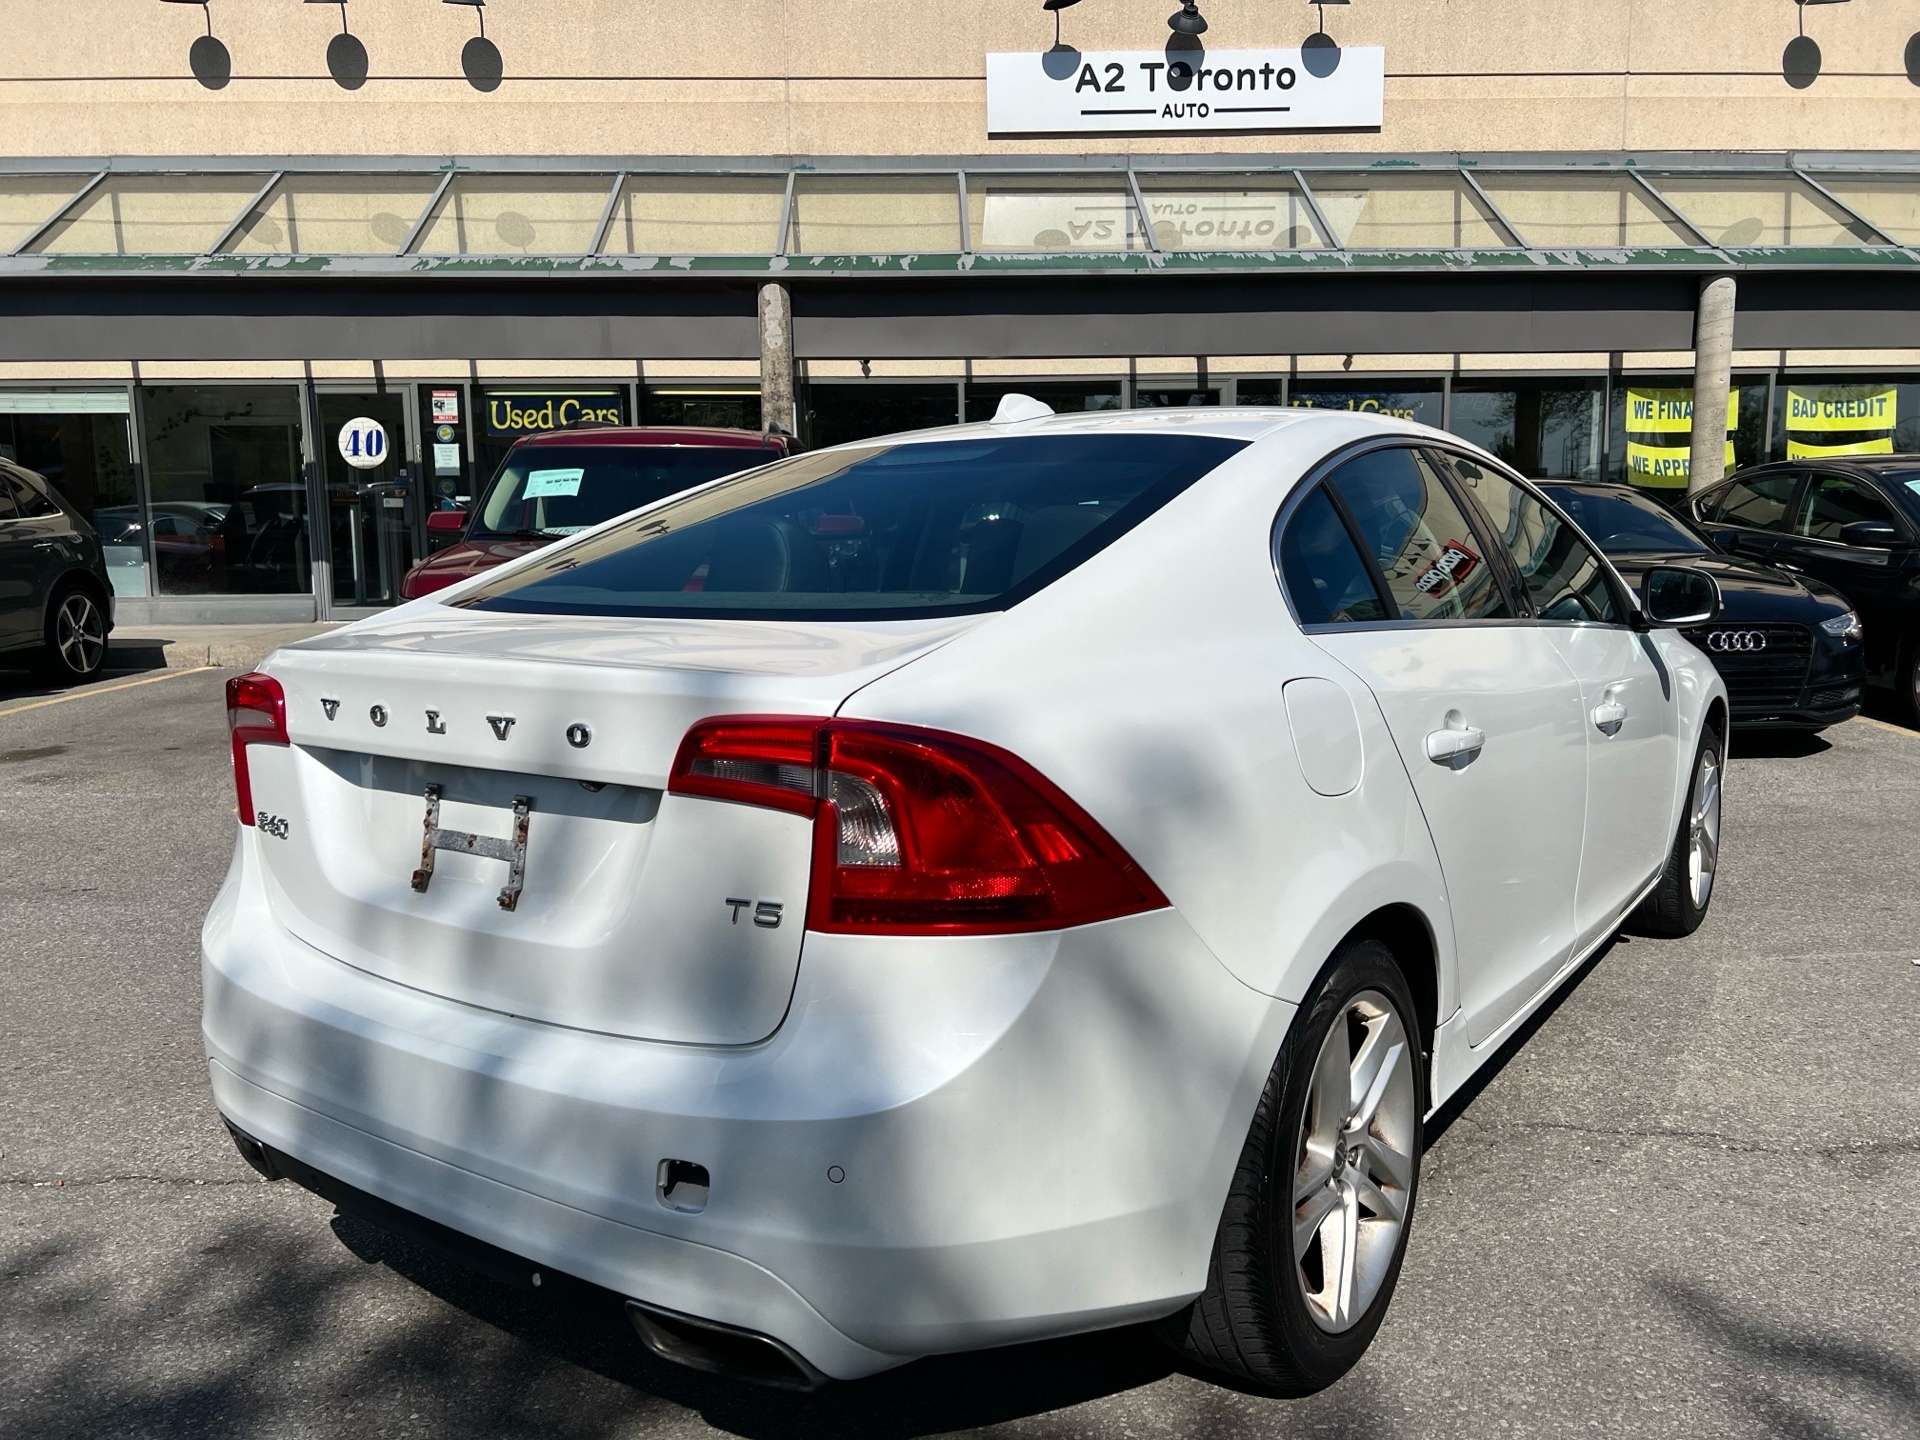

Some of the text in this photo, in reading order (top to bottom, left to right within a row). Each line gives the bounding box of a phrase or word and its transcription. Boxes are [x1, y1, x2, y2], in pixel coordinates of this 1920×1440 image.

[1075, 62, 1296, 93] A2 Tronto
[1161, 103, 1210, 119] AUTO
[490, 400, 555, 430] Used
[559, 399, 619, 426] Cars
[1633, 400, 1653, 420] WE
[1792, 397, 1887, 418] BAD CREDIT
[345, 429, 384, 457] 40
[1632, 455, 1651, 475] WE
[320, 697, 592, 749] VOLVO
[257, 811, 289, 840] S60
[725, 897, 784, 929] T5
